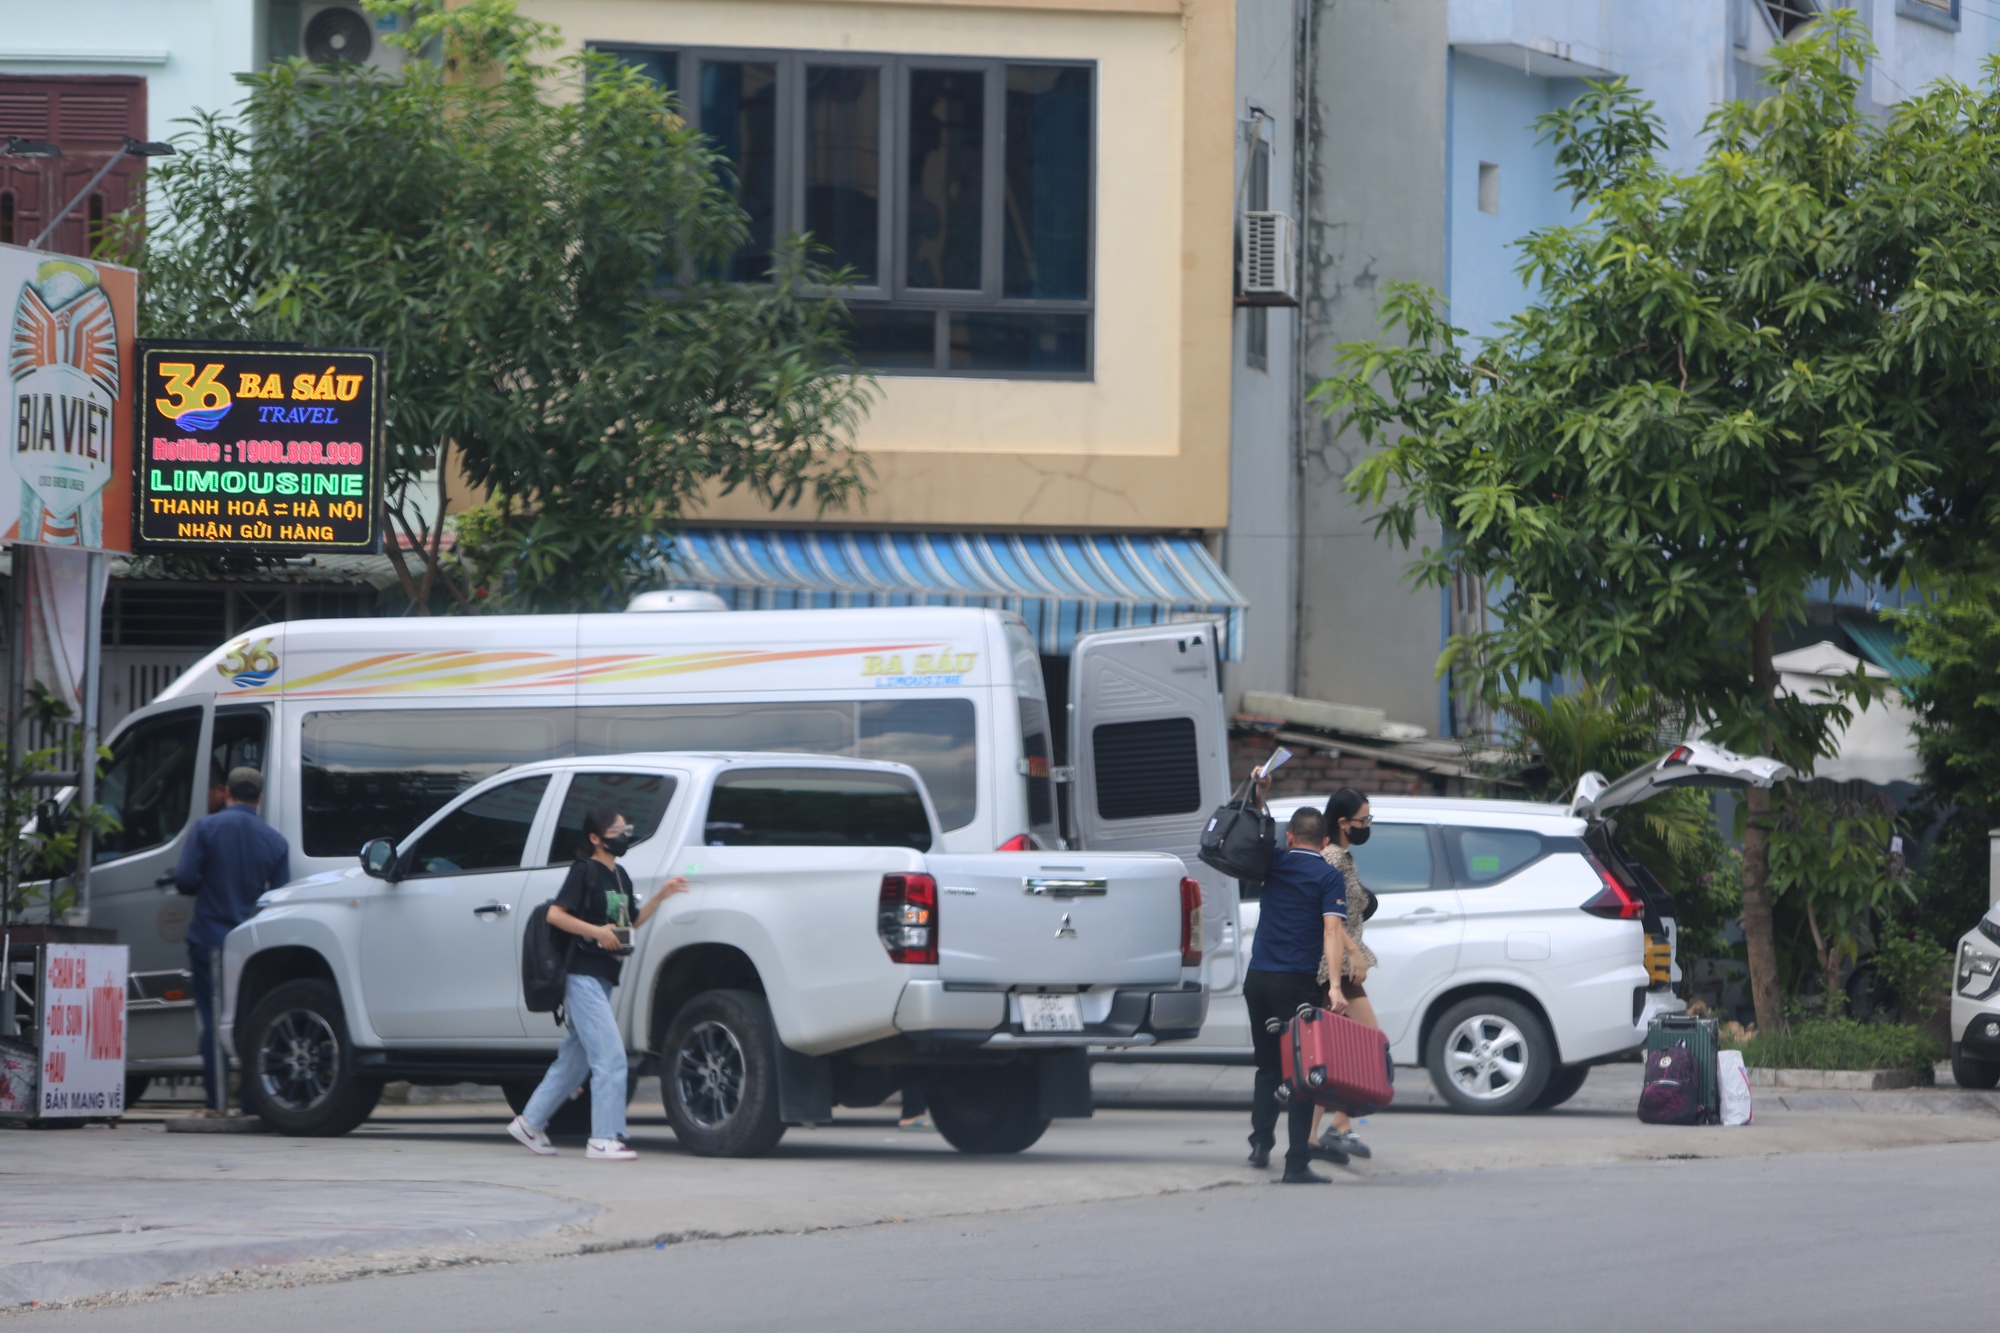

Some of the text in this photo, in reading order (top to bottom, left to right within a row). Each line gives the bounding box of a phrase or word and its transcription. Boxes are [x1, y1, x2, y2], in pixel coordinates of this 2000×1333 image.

[155, 362, 232, 419] 36
[236, 366, 364, 401] BA SÁU
[258, 406, 339, 424] TRAVEL
[18, 391, 109, 470] BIA VIỆT
[152, 438, 220, 462] Hotline
[236, 440, 363, 465] 1900.888.999
[150, 469, 364, 496] LIMOUSINE
[150, 499, 219, 515] THANH
[292, 500, 320, 518] HÀ
[328, 501, 363, 521] NỘI
[178, 521, 334, 541] NHẬN GỬI HÀNG
[861, 647, 979, 676] BA SÁU
[45, 1087, 68, 1109] BÁN
[70, 1092, 105, 1109] MANG
